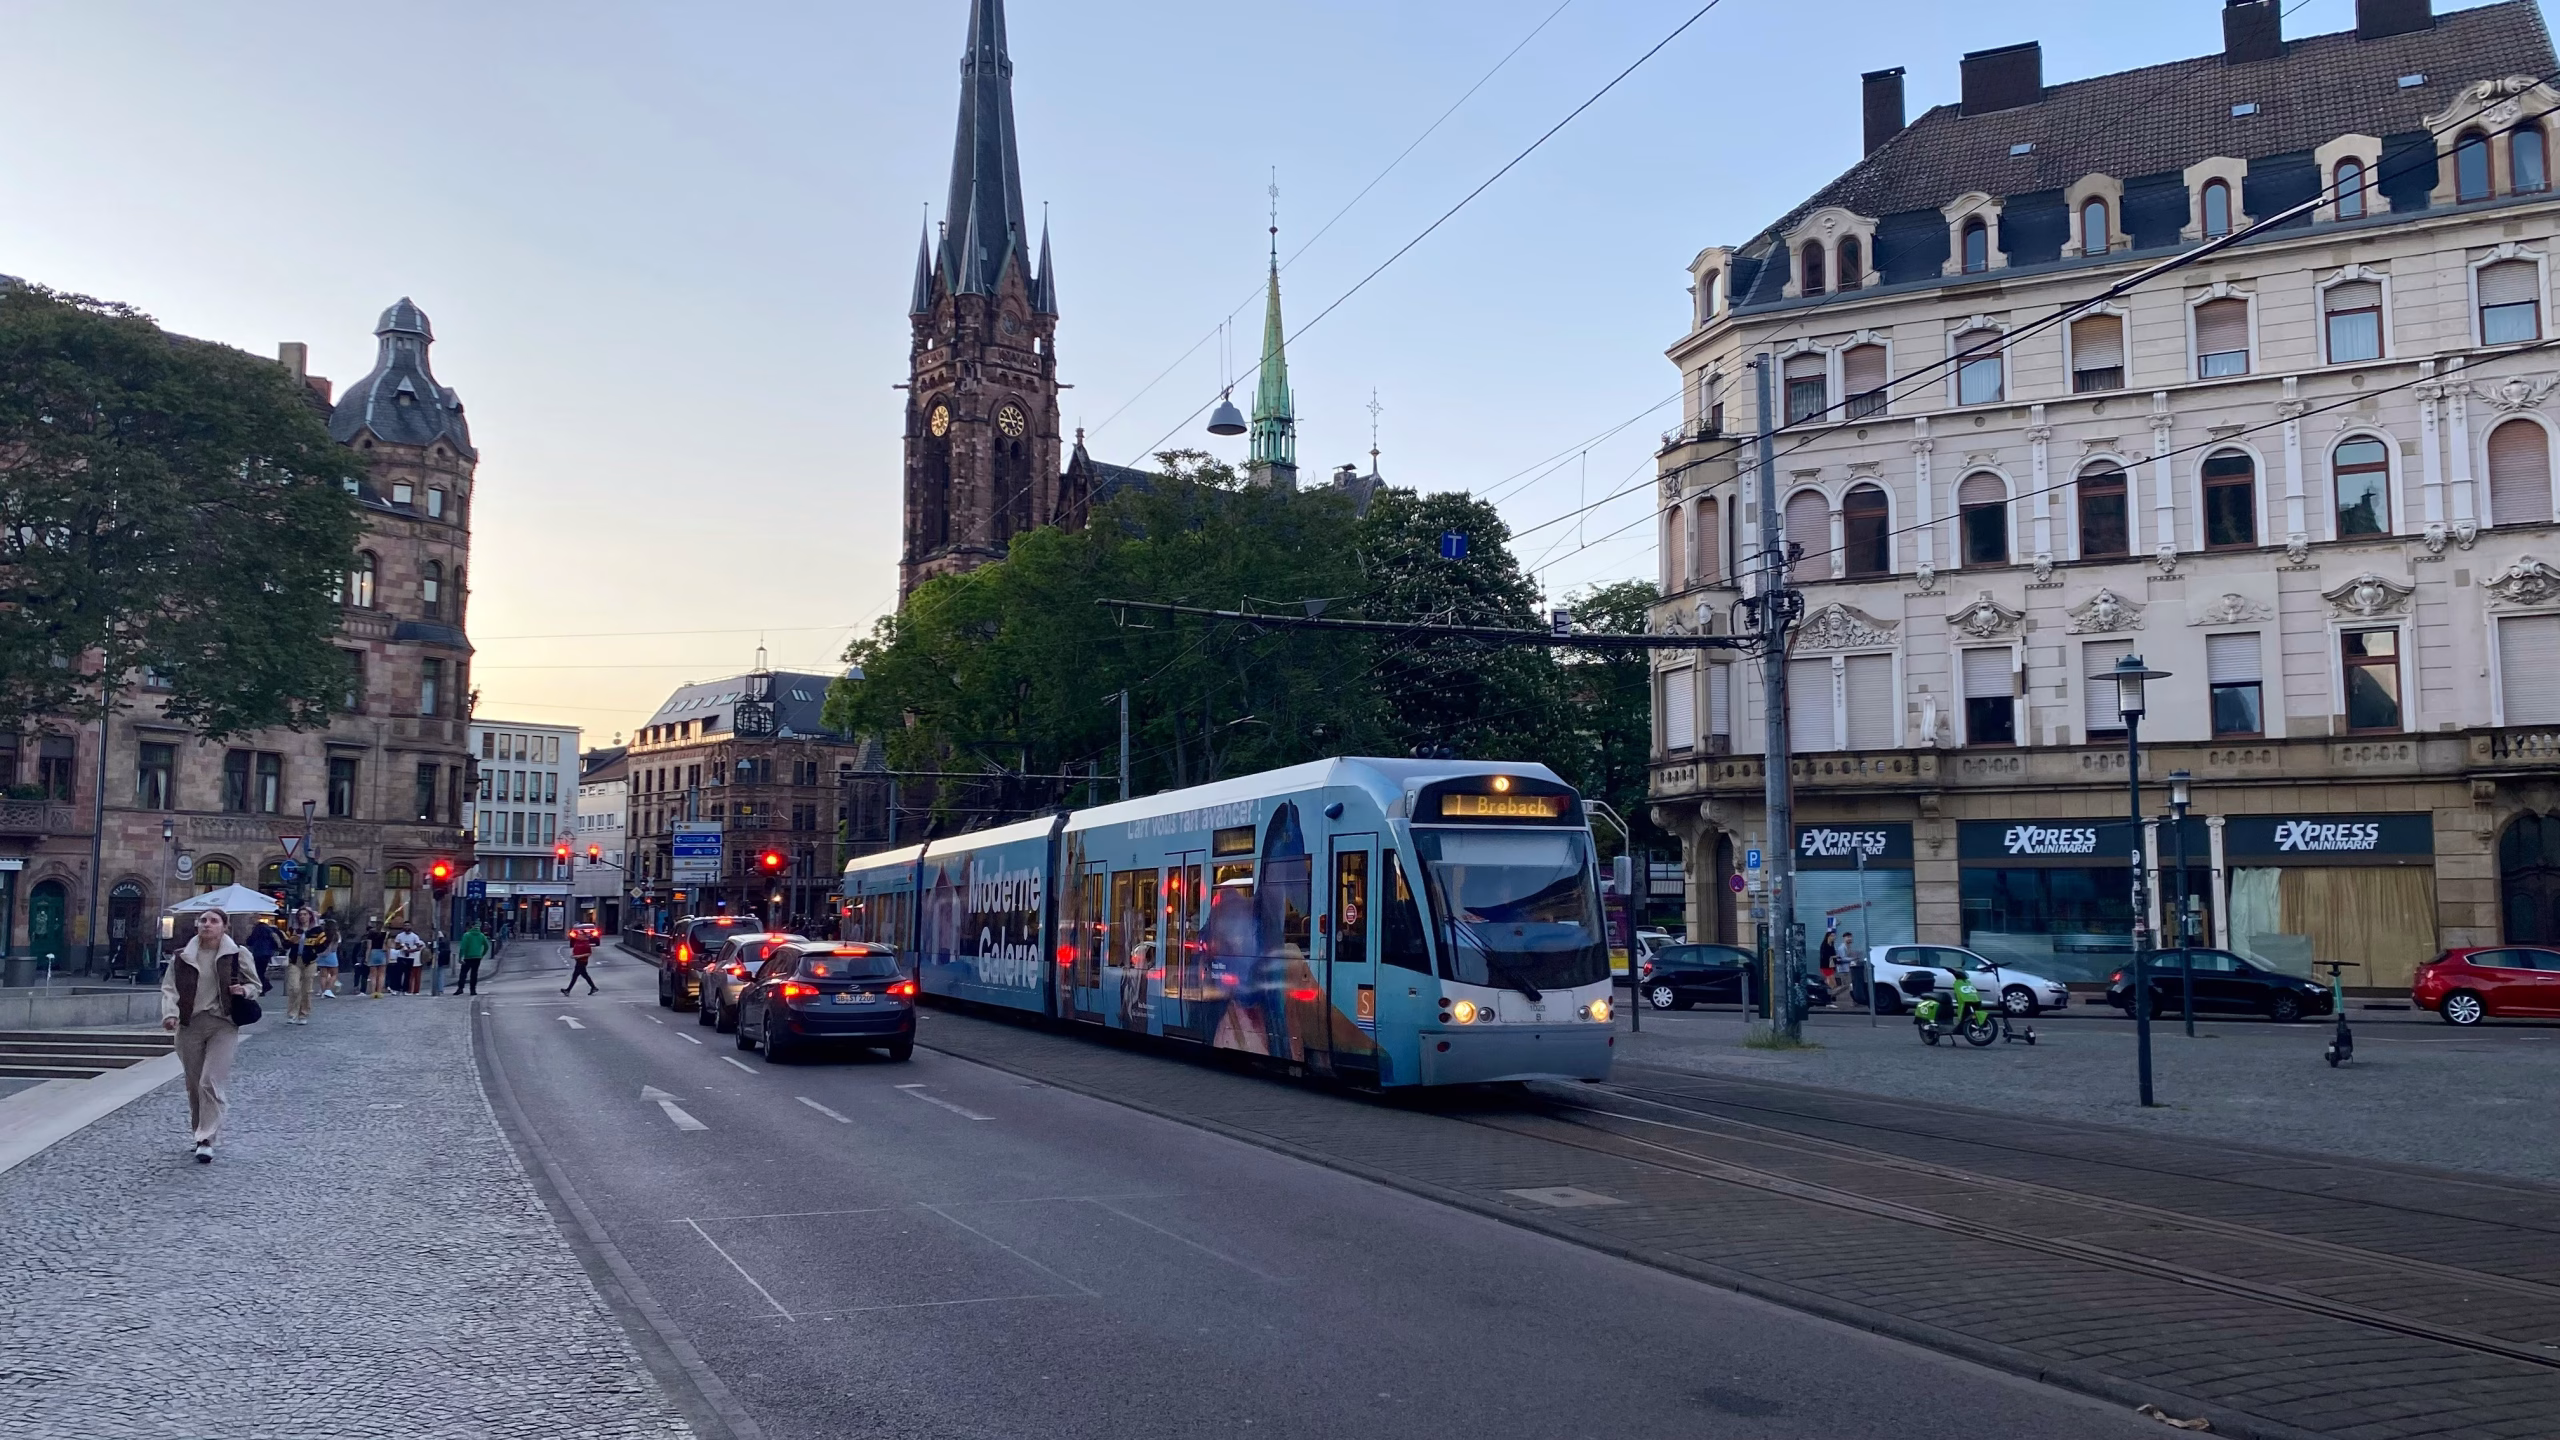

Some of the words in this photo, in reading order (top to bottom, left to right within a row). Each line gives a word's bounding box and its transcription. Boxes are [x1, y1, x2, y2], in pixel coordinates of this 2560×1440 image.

[1447, 535, 1462, 556] T
[1553, 611, 1568, 634] E
[1456, 794, 1462, 815] 1
[1477, 796, 1547, 815] Brebach
[1152, 813, 1177, 837] vous
[1201, 800, 1254, 830] avancer
[1800, 829, 1887, 856] EXPRESS
[2003, 825, 2097, 854] EXPRESS
[2273, 820, 2380, 851] EXPRESS
[1750, 851, 1758, 866] P
[1827, 846, 1885, 856] MINIRKT
[968, 854, 1041, 914] Moderne
[978, 925, 1039, 990] Galerie
[1361, 991, 1370, 1014] S
